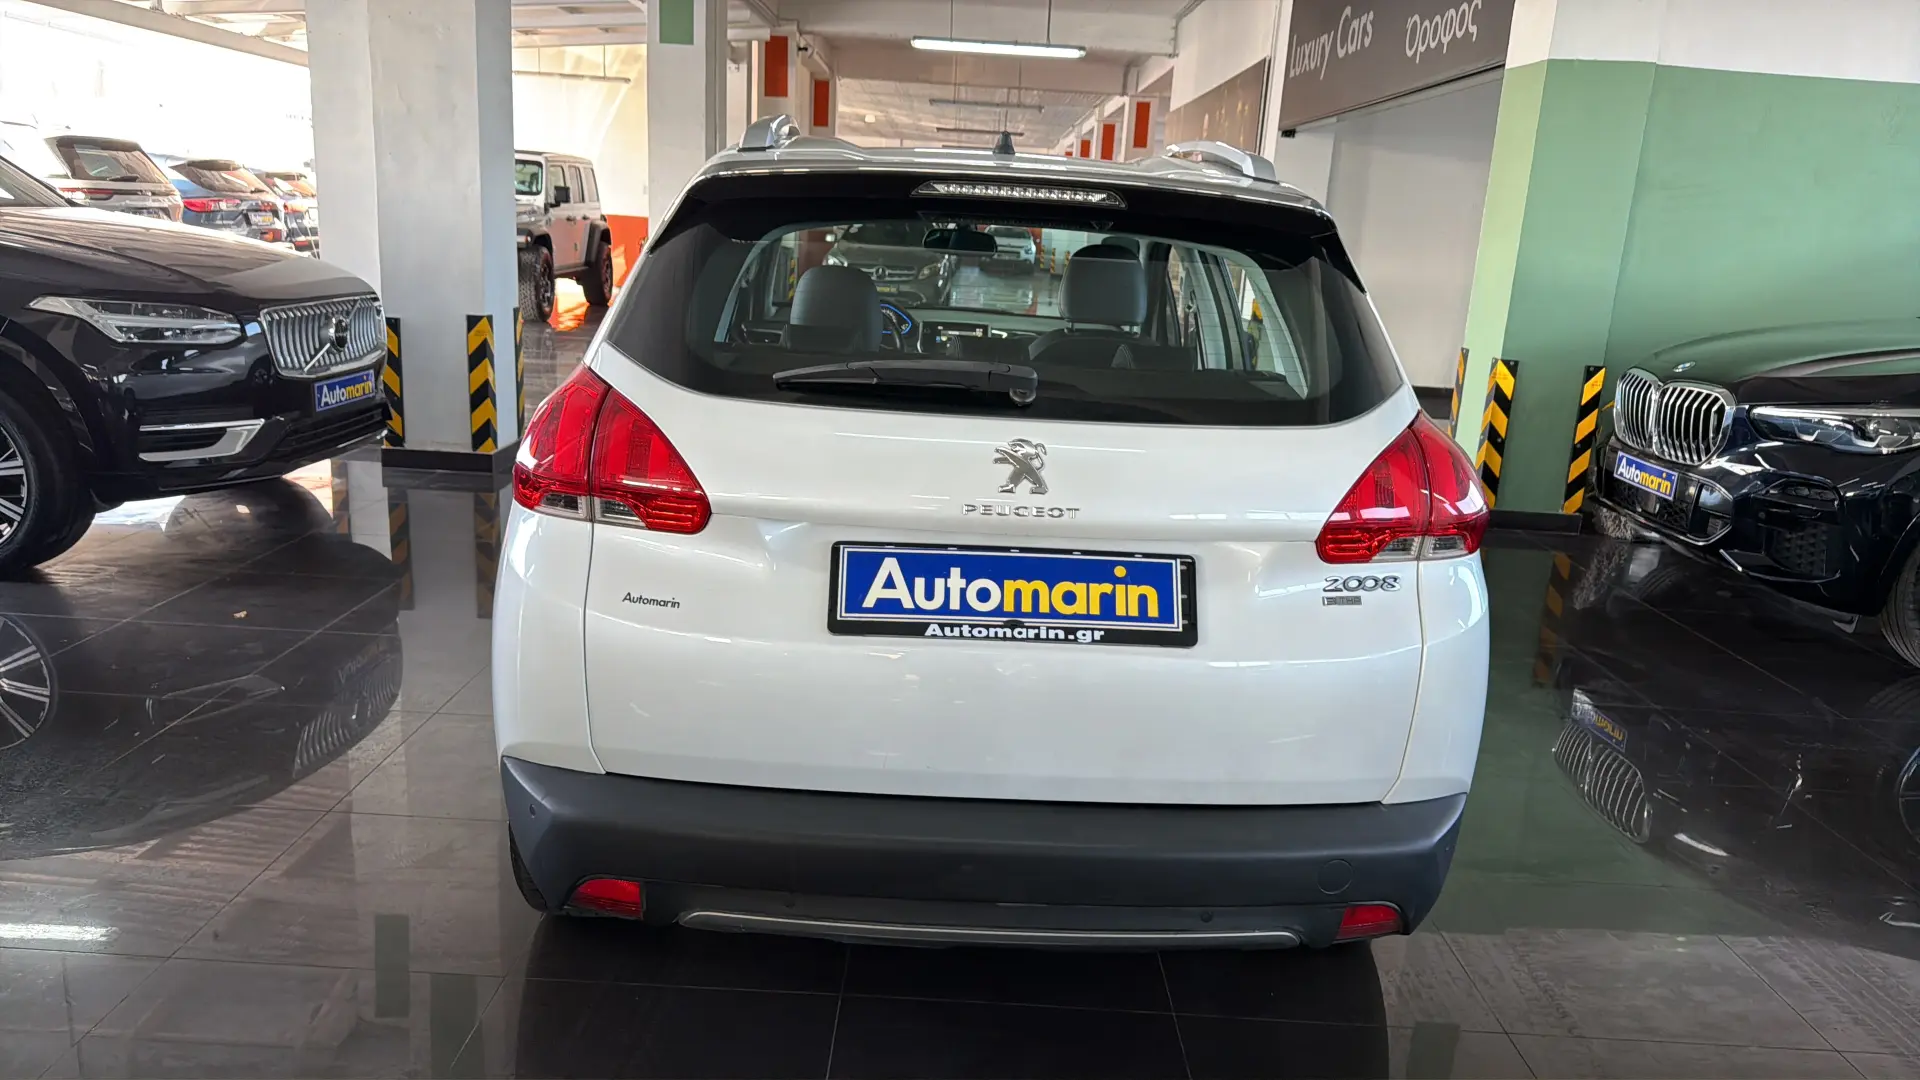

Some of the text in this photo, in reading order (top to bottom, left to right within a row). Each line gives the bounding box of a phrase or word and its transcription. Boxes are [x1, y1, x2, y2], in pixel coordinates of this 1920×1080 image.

[1289, 6, 1374, 80] Luxury Cars
[320, 375, 373, 407] Automarin
[1617, 456, 1671, 495] Automarin
[962, 503, 1081, 519] PEUGEOT
[861, 556, 1160, 618] Automarin
[1322, 575, 1401, 592] 2008
[622, 591, 681, 609] Automarin
[924, 622, 1105, 643] Automarin.gr
